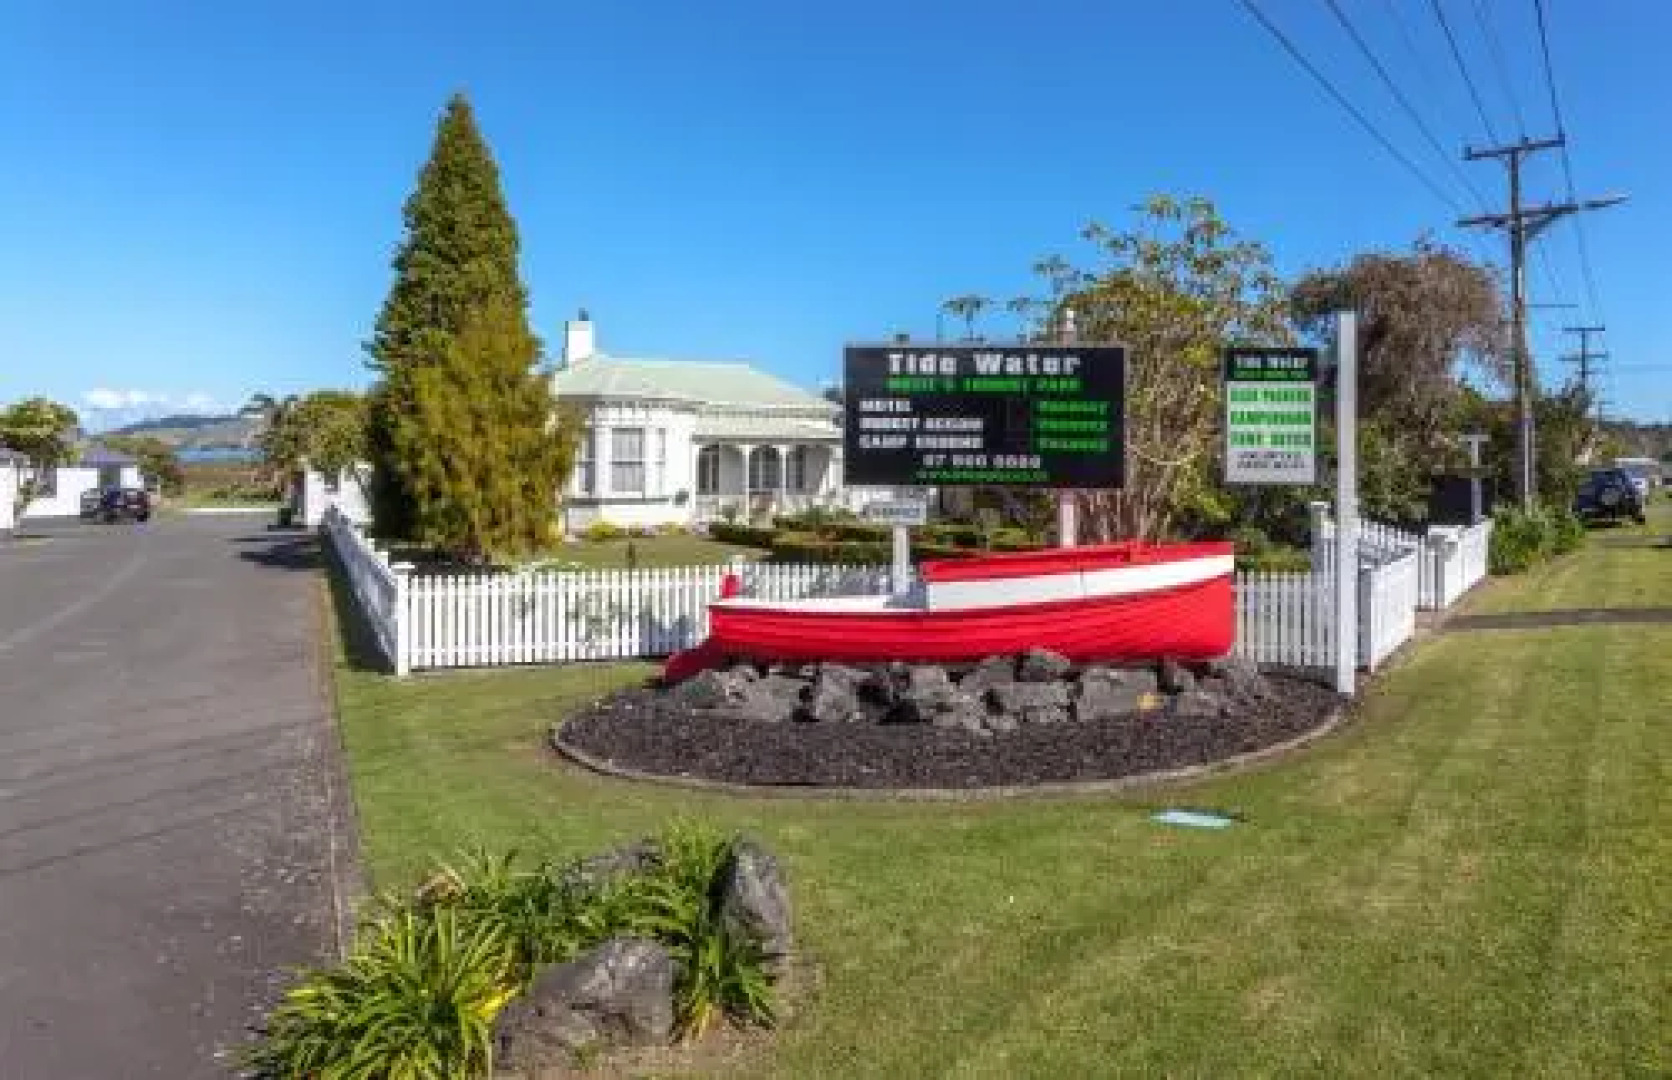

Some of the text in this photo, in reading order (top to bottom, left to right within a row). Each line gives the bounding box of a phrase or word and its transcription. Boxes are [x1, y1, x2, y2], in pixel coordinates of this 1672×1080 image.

[888, 353, 1081, 375] Tide Water
[859, 398, 911, 412] MOTEL
